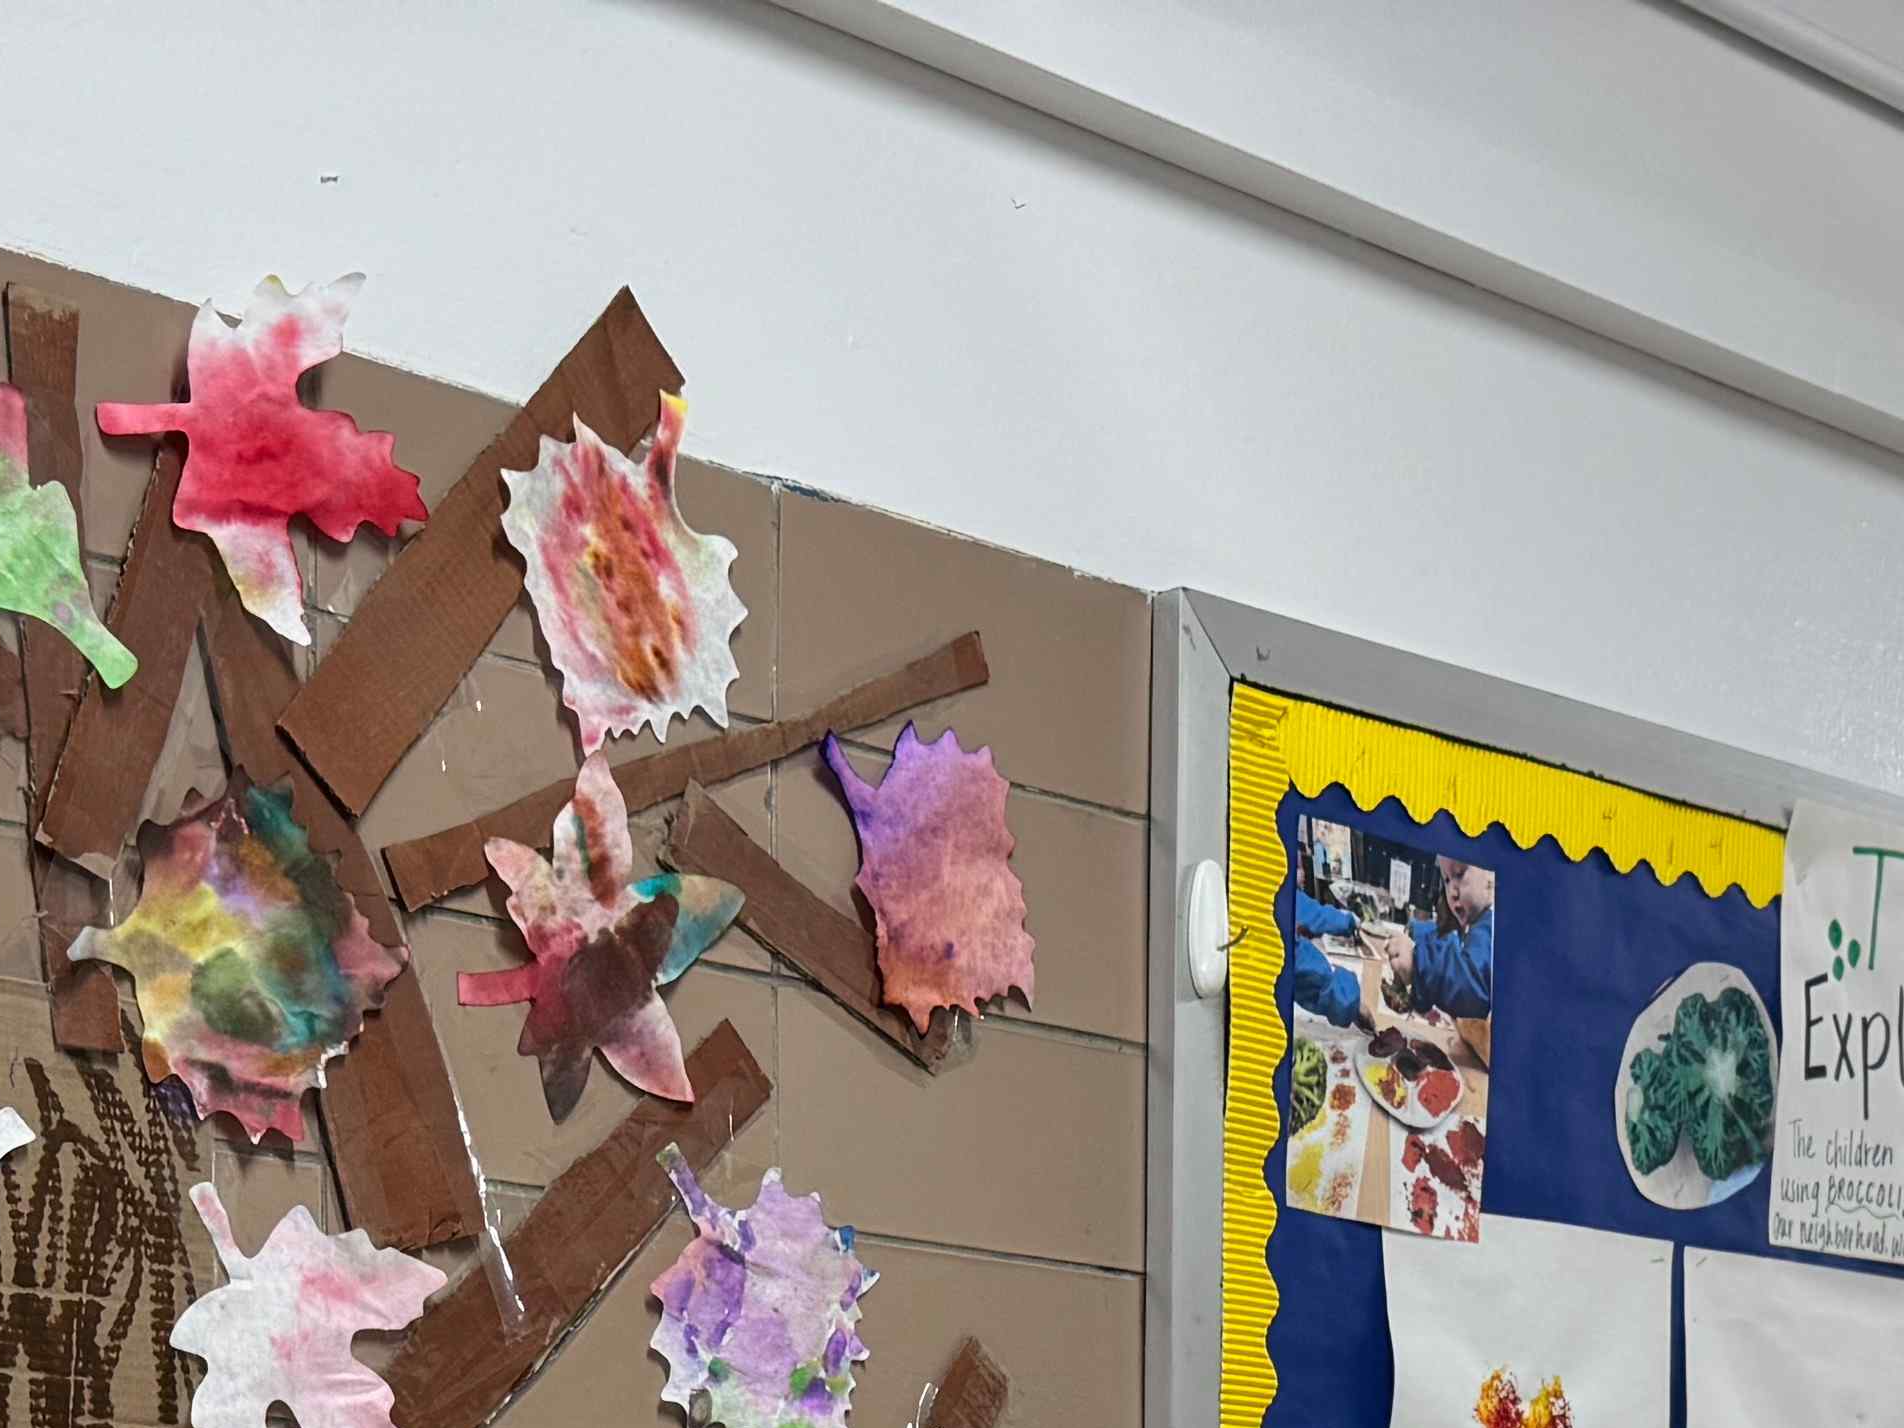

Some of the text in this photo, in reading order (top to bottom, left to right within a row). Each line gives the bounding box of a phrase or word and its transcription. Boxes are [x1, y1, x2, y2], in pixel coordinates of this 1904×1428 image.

[1788, 1118, 1816, 1160] The
[1825, 1129, 1894, 1169] children
[1780, 1177, 1820, 1218] using
